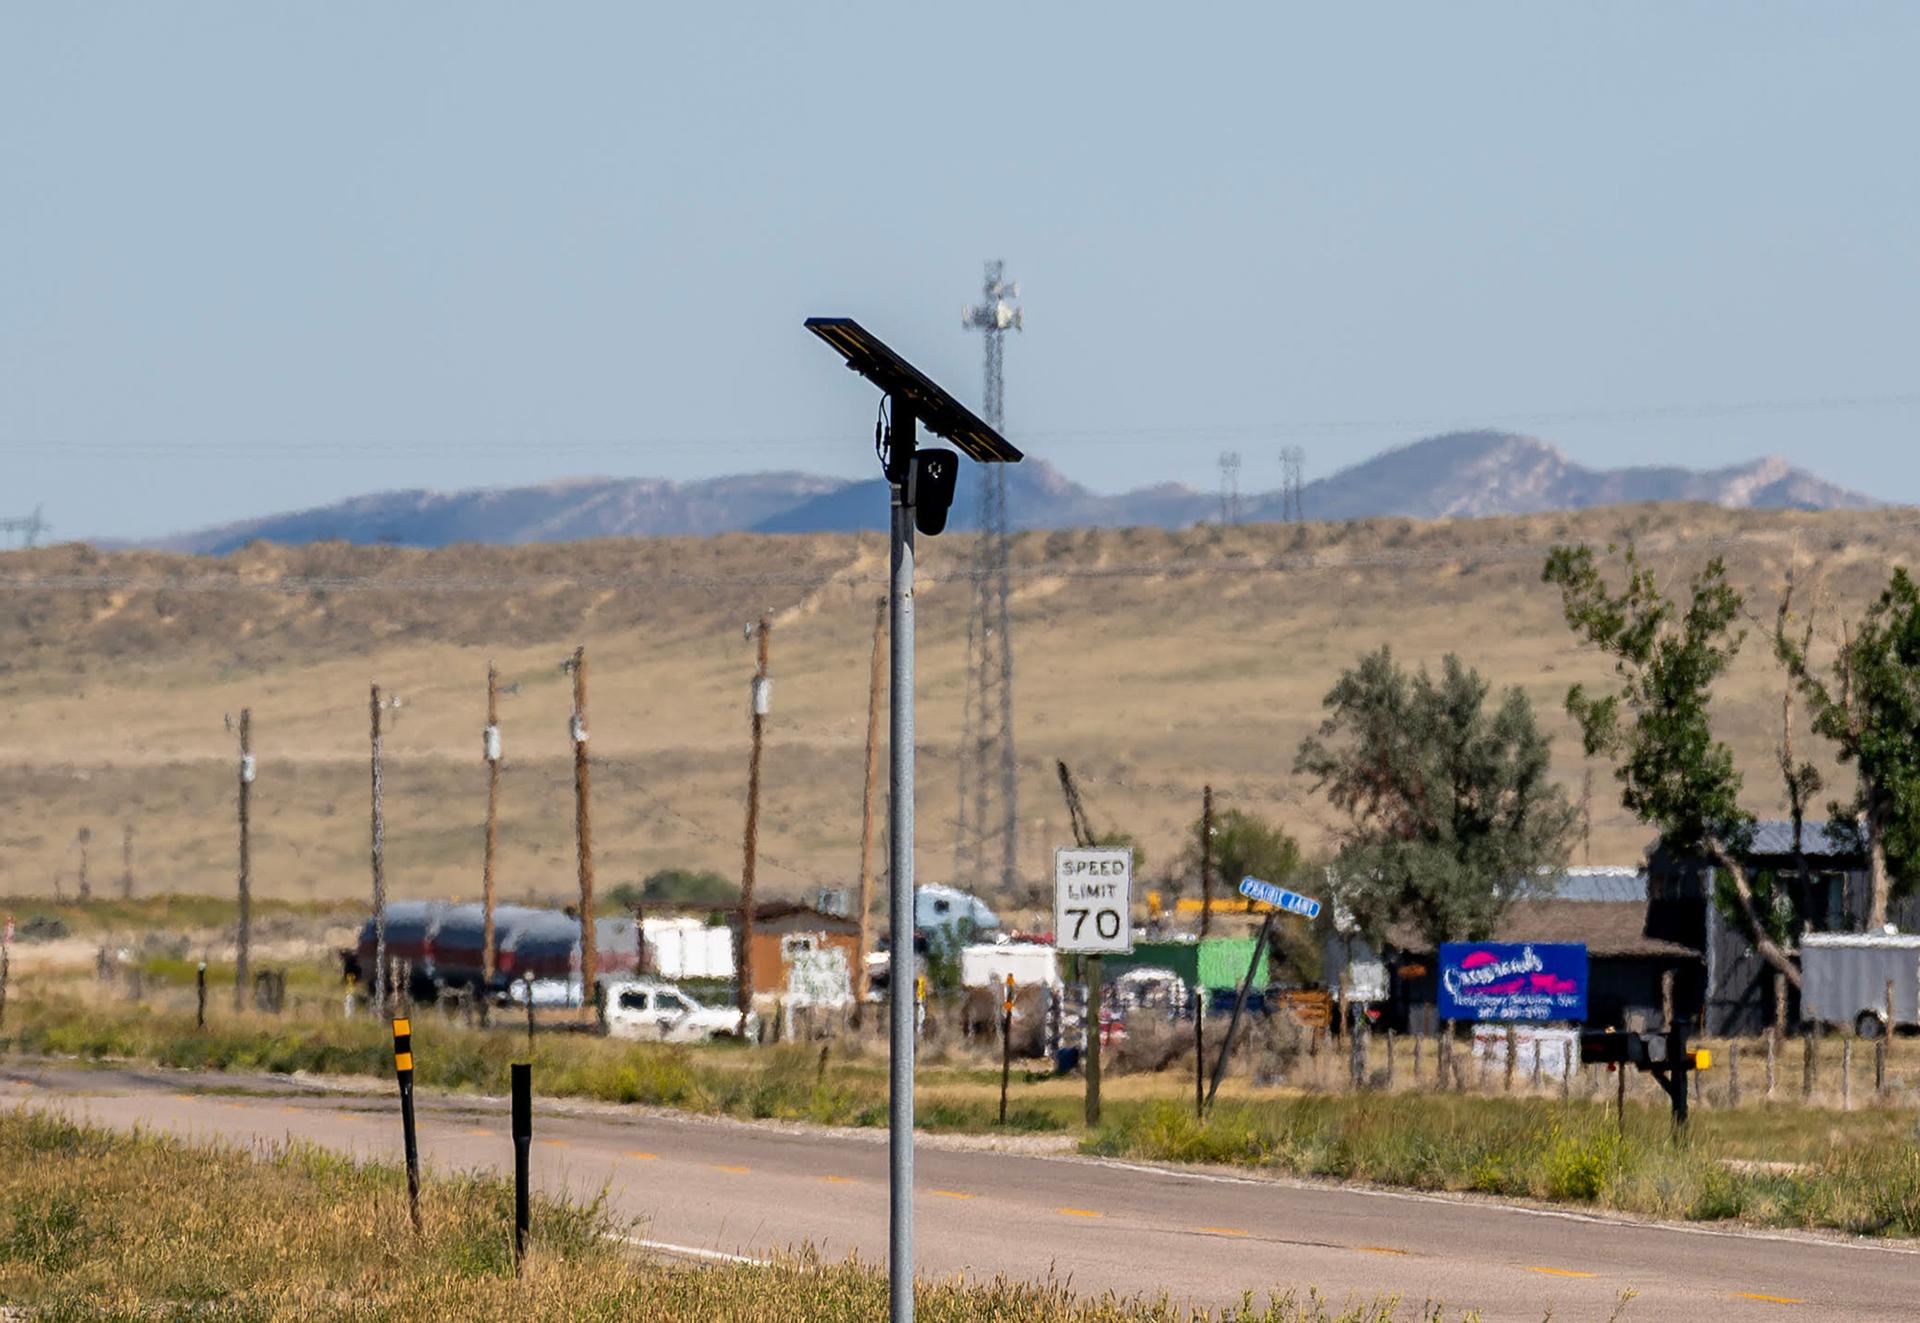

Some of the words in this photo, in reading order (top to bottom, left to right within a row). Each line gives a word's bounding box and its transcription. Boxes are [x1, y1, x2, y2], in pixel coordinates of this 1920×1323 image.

[1062, 861, 1124, 875] SPEED
[1068, 884, 1116, 899] LIMIT
[1065, 908, 1120, 940] 70
